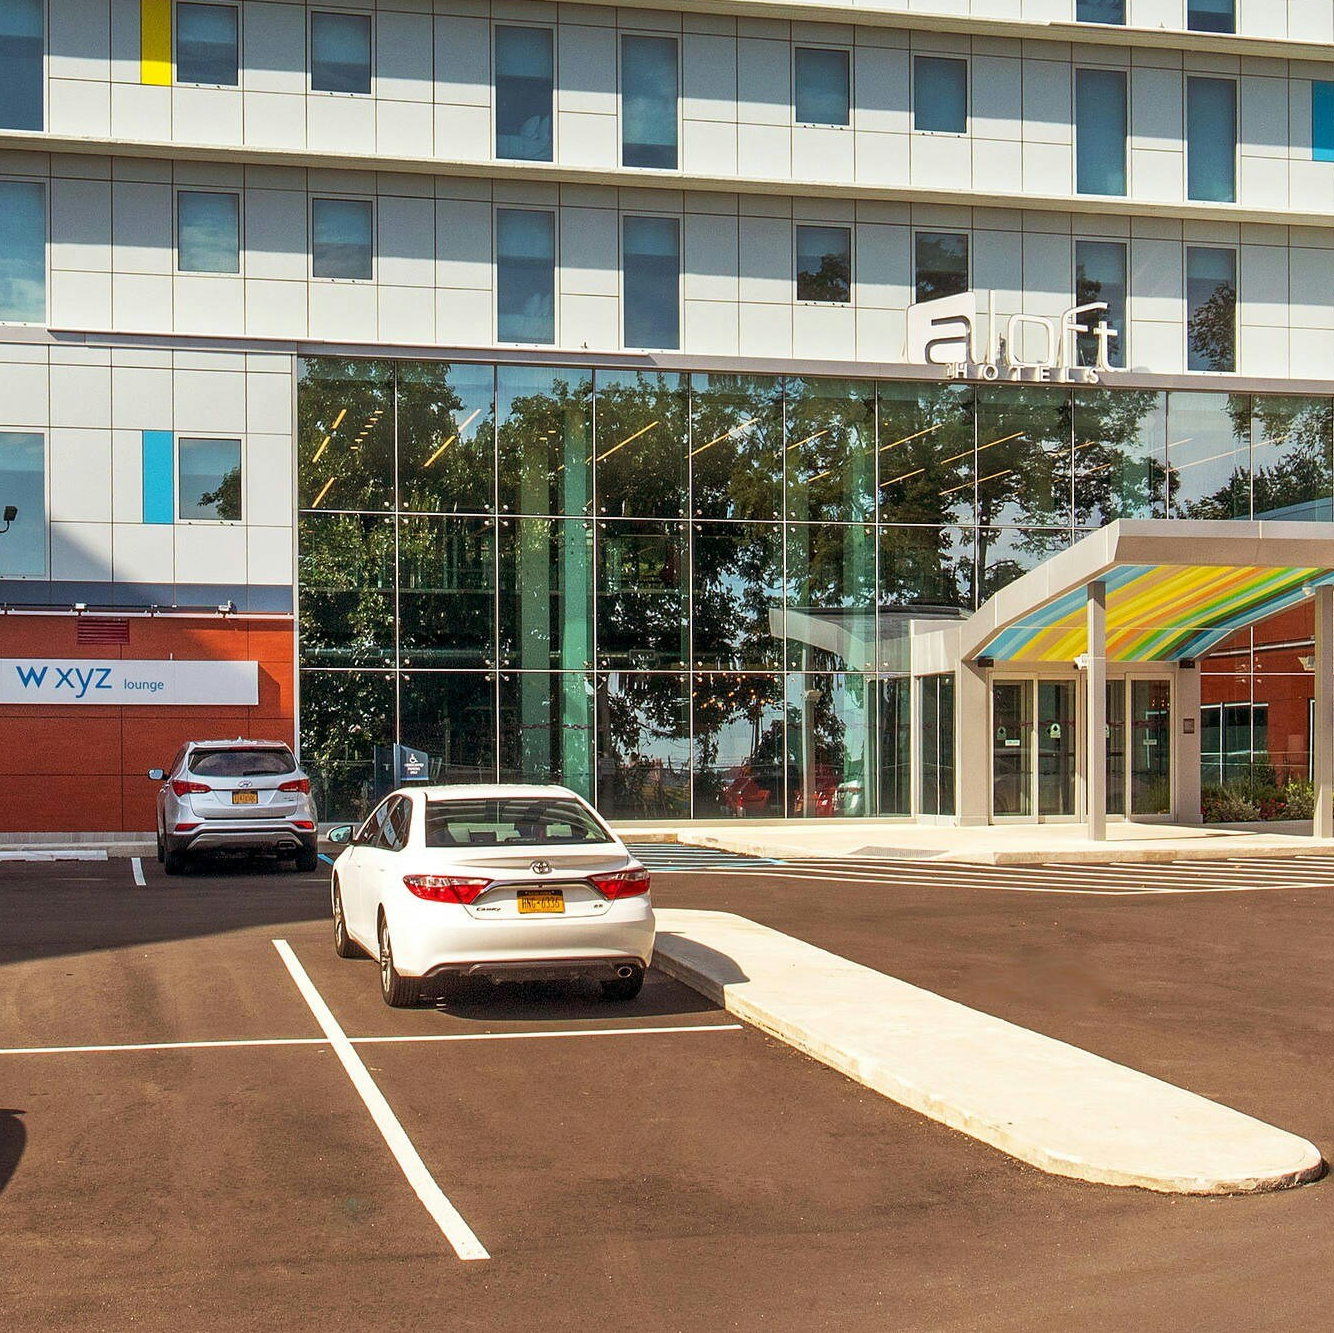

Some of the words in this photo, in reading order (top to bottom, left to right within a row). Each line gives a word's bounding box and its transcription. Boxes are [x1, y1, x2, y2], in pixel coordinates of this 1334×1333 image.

[906, 289, 1127, 372] aloft
[946, 363, 1100, 384] HOTELS
[124, 678, 165, 693] lounge
